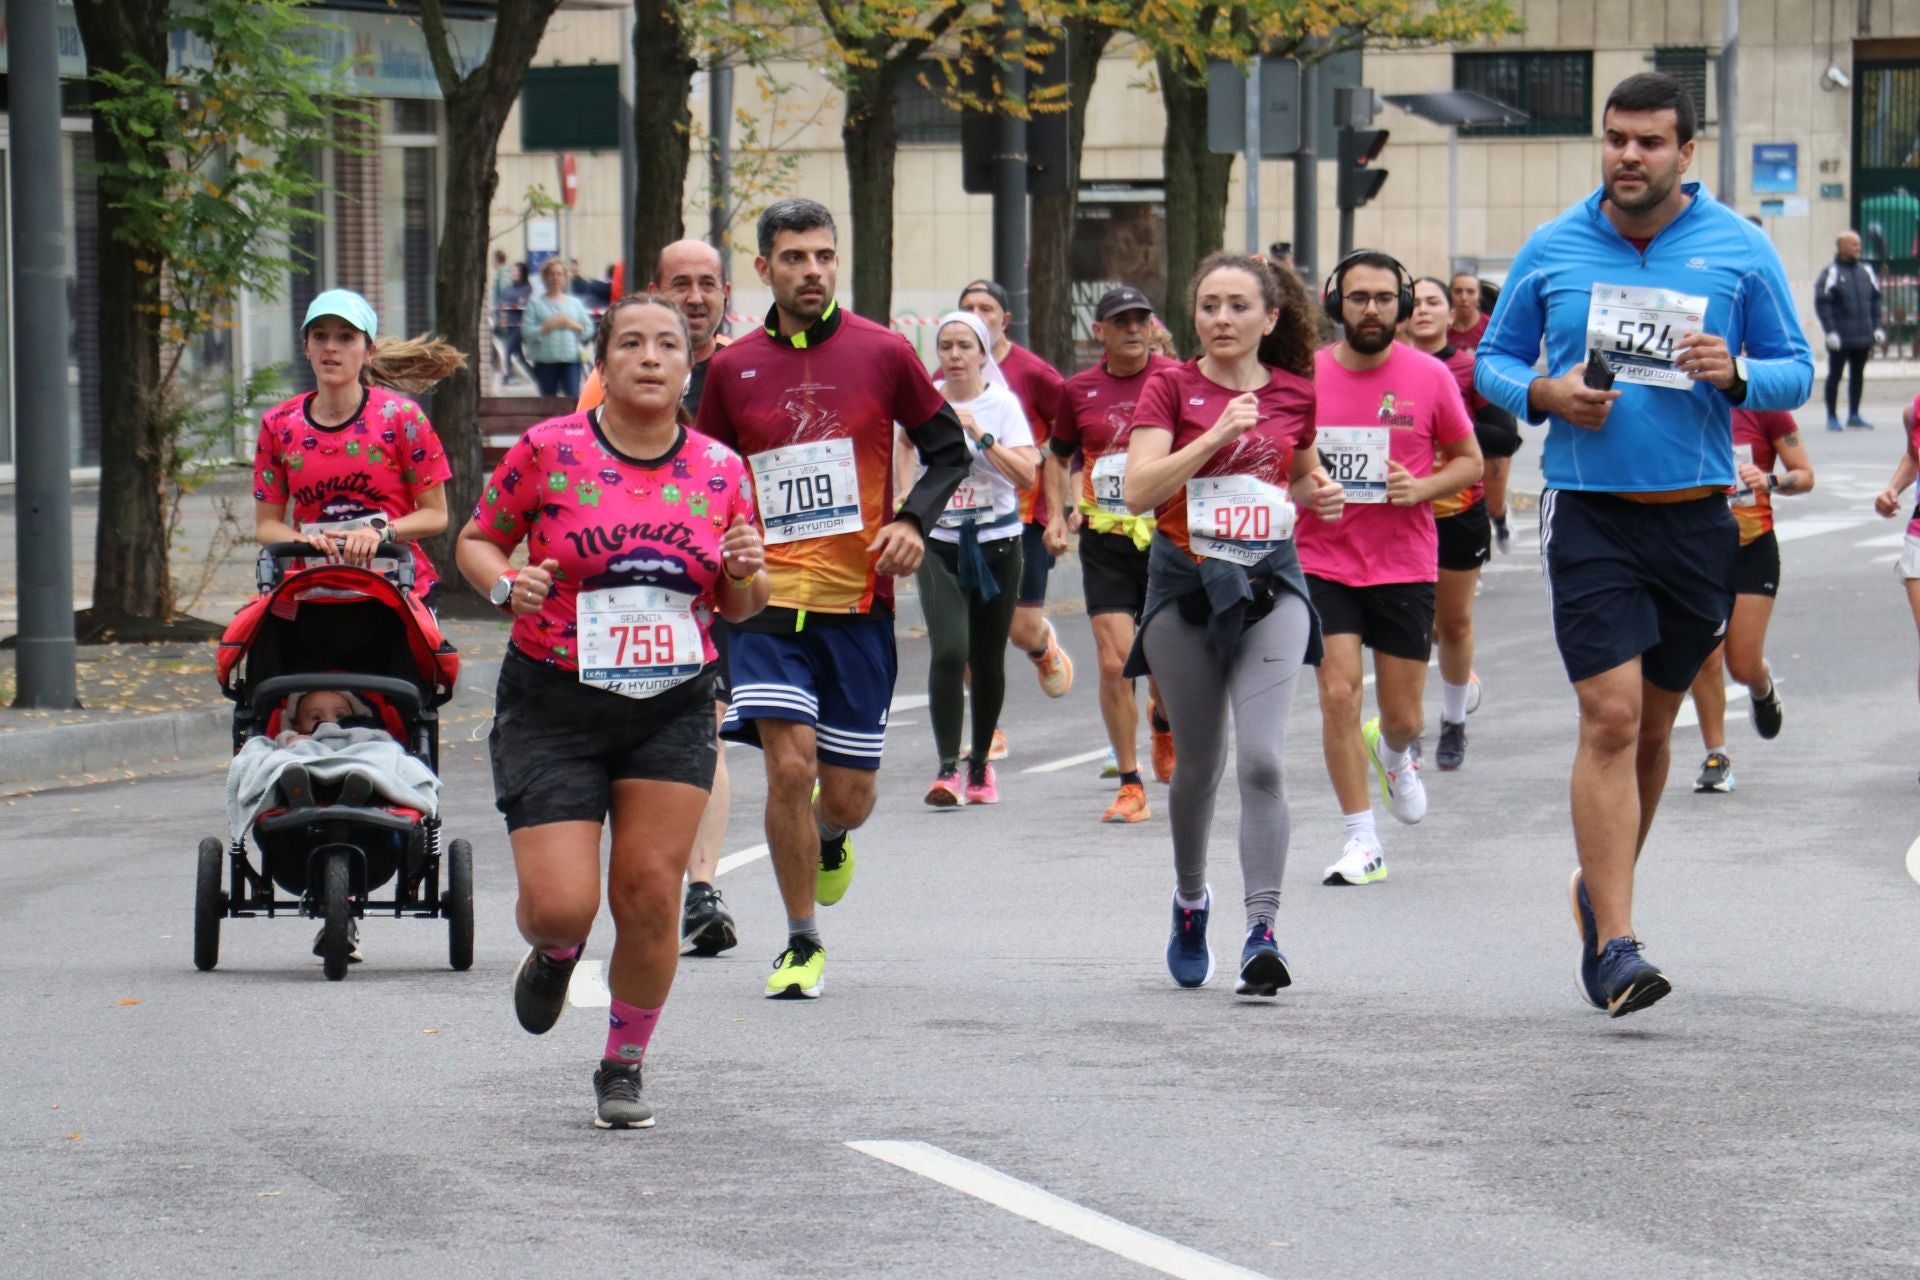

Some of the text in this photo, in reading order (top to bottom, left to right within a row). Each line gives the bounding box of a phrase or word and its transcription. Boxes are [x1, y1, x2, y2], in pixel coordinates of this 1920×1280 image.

[1615, 320, 1675, 359] 524
[1628, 366, 1677, 380] HYUNDAI
[801, 465, 820, 475] VEGA
[779, 474, 833, 513] 709
[1343, 490, 1374, 498] UNDAI
[798, 519, 844, 532] HYUNDAI
[1215, 506, 1270, 539] 920
[564, 521, 719, 573] Monstruo
[620, 613, 664, 624] SELENITA
[609, 625, 675, 666] 759
